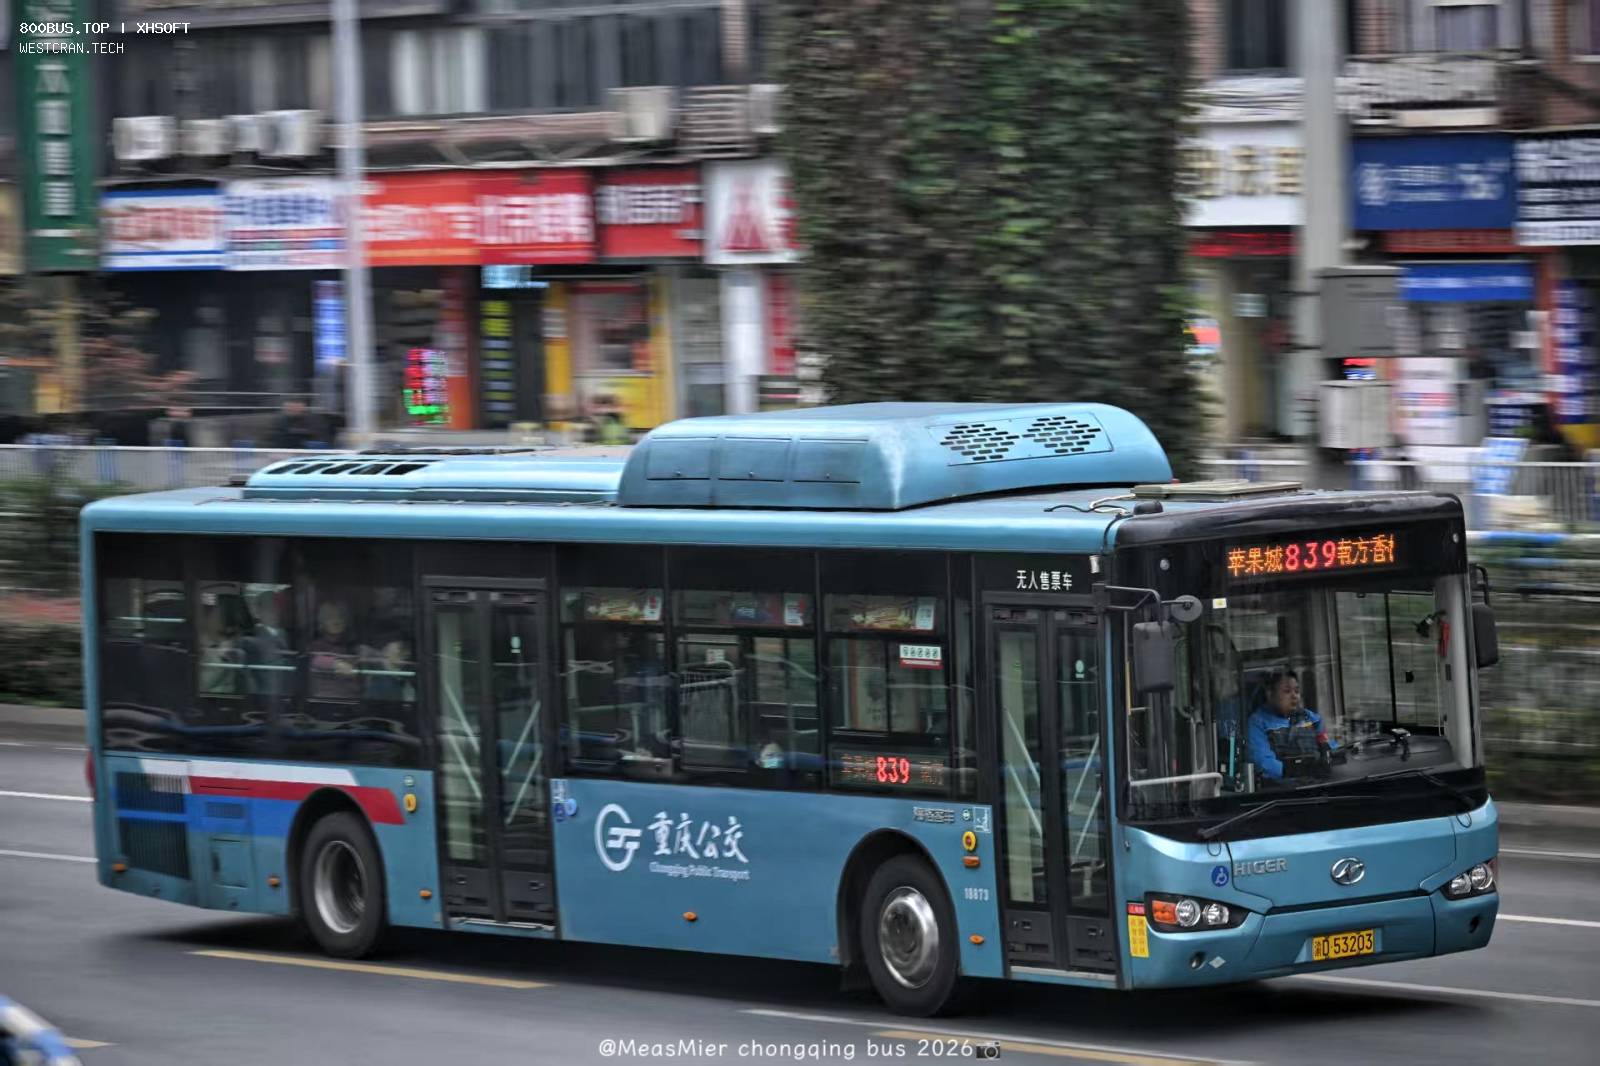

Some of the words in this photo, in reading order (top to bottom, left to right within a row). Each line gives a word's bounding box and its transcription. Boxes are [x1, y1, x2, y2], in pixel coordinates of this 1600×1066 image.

[1285, 540, 1336, 571] 839
[1016, 569, 1073, 591] 无人售票车
[876, 756, 909, 784] 839
[647, 811, 749, 863] 重庆公交
[1233, 857, 1288, 877] HIGER
